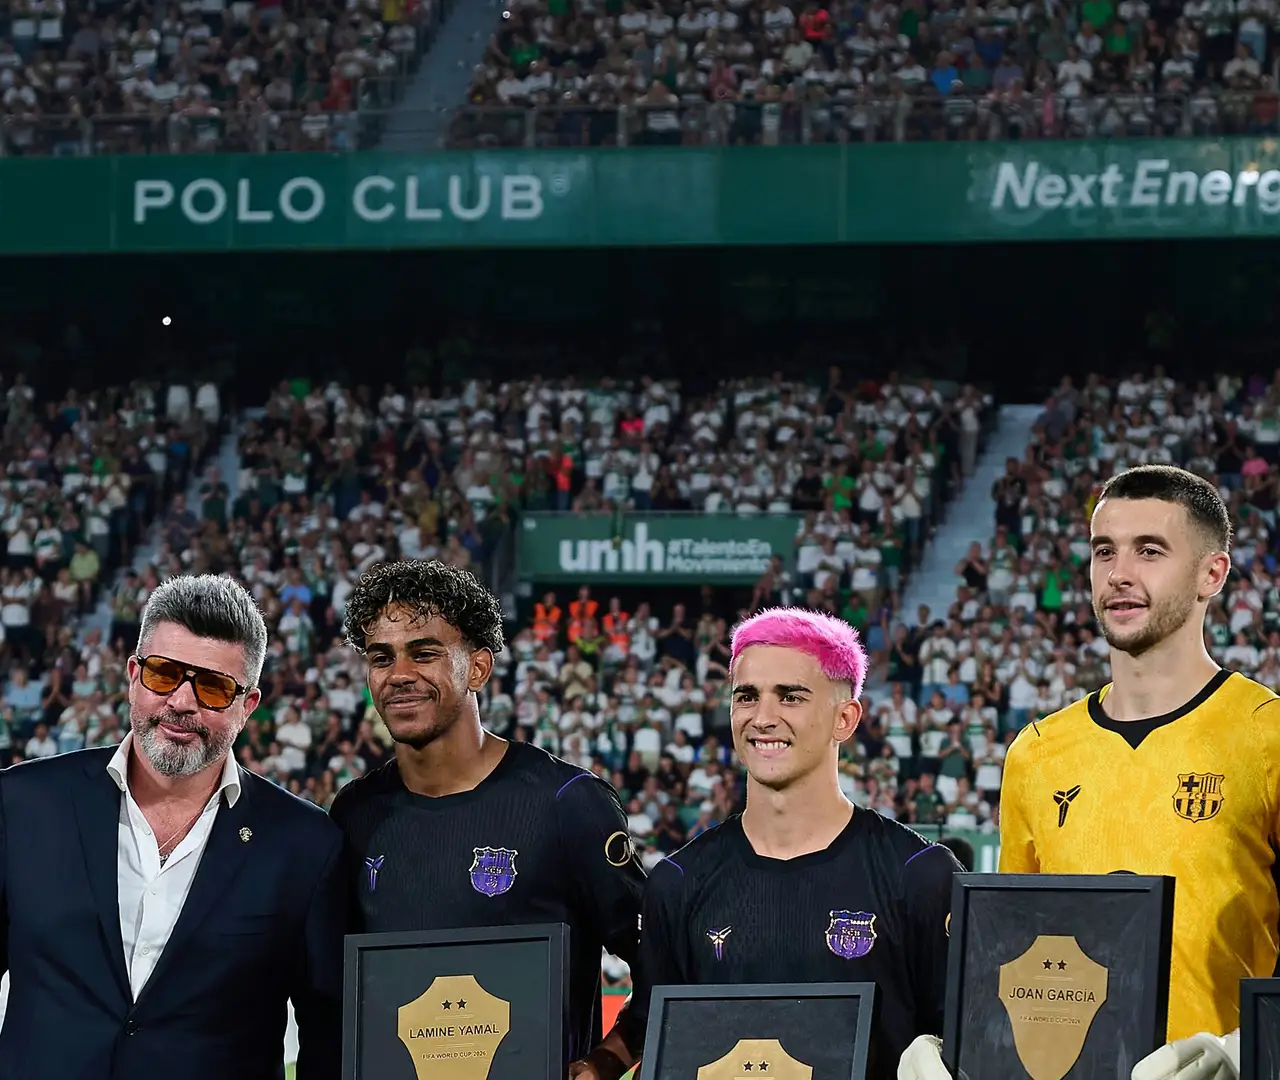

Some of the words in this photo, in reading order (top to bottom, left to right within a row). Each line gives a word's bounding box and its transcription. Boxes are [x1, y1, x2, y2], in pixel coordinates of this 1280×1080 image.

[134, 176, 325, 224] POLO
[352, 174, 544, 221] CLUB
[559, 522, 665, 572] umh
[1009, 987, 1043, 999] JOAN
[1048, 989, 1095, 1002] GARCÍA
[410, 1027, 454, 1038] LAMINE
[458, 1024, 499, 1035] YAMAL
